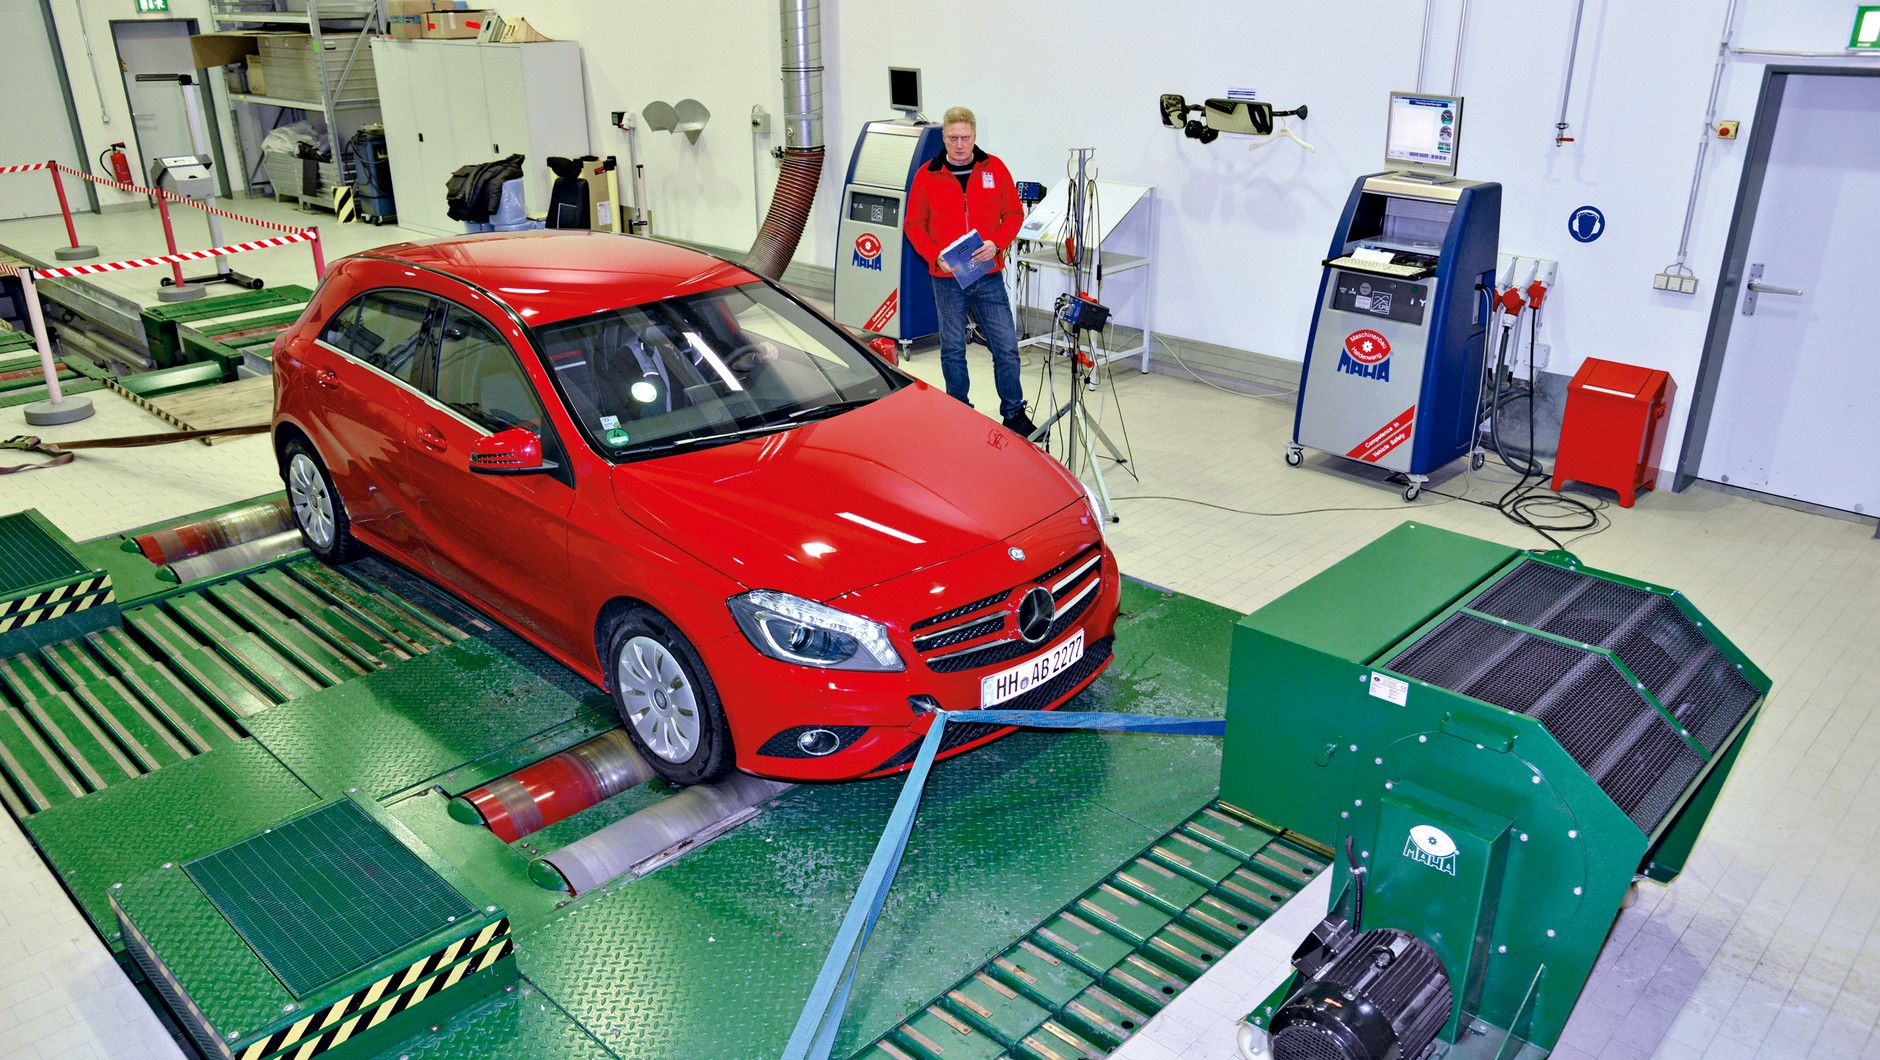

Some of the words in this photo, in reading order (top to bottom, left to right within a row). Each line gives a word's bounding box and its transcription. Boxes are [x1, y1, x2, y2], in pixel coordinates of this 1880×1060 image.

[852, 248, 881, 271] MAHA
[1350, 332, 1387, 349] Maschinenbau
[1337, 348, 1390, 382] MAHA
[1365, 427, 1393, 448] Competence
[1372, 444, 1390, 457] Vehicle
[1390, 433, 1405, 445] Safety
[996, 671, 1019, 699] HH
[1031, 658, 1049, 685] AB
[1053, 635, 1082, 674] 2277
[1403, 835, 1455, 876] MAHA
